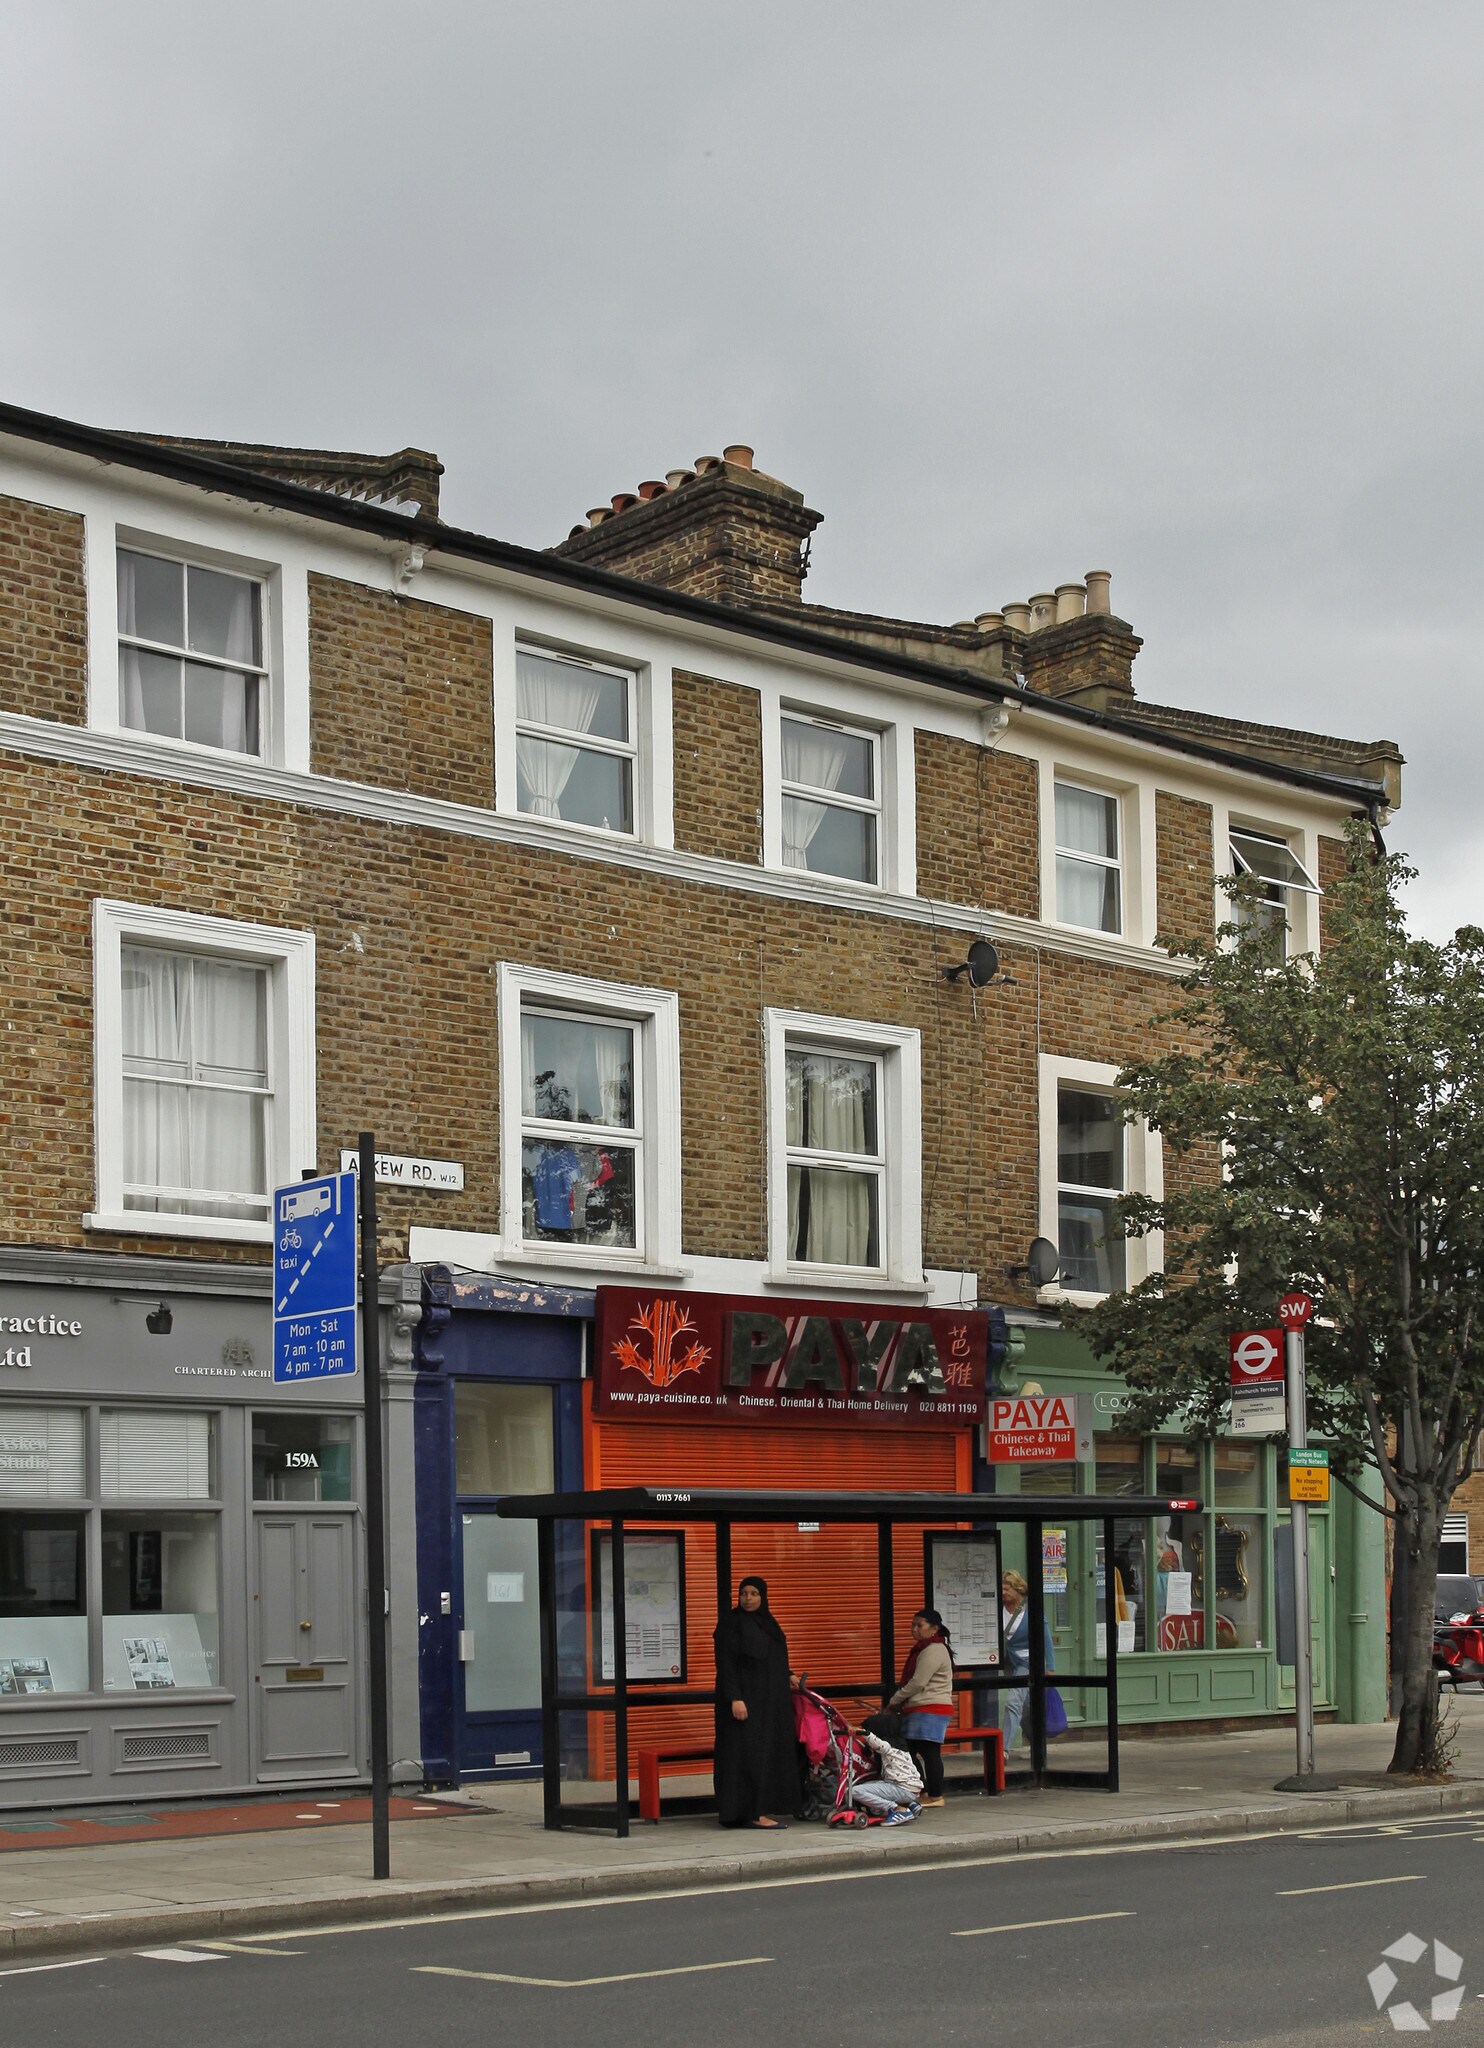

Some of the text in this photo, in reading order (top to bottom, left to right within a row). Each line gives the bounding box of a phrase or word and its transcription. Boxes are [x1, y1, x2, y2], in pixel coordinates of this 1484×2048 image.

[348, 1158, 403, 1177] AKEW
[412, 1165, 436, 1181] RD.
[280, 1255, 298, 1269] taxi
[1280, 1301, 1306, 1318] SW
[290, 1324, 310, 1337] Mon
[320, 1318, 338, 1333] Sat
[283, 1344, 290, 1357] 7
[292, 1346, 306, 1356] am
[316, 1339, 327, 1353] 10
[330, 1339, 345, 1350] am
[729, 1311, 947, 1394] PAYA
[174, 1366, 273, 1378] CHARTERED ARCHI
[285, 1361, 292, 1374] 4
[295, 1362, 310, 1375] pm
[319, 1357, 326, 1370] 7
[328, 1357, 344, 1371] pm
[716, 1395, 727, 1404] uk
[780, 1396, 815, 1408] Oriental
[817, 1398, 824, 1408] &
[827, 1399, 845, 1409] Thai
[848, 1400, 871, 1410] Home
[874, 1401, 908, 1413] Delivery
[919, 1402, 934, 1412] 020
[937, 1403, 955, 1413] 8811
[958, 1404, 977, 1413] 1199
[993, 1398, 1070, 1429] PAYA
[994, 1430, 1070, 1445] Chinese & Thai
[1008, 1446, 1057, 1457] Takeaway
[285, 1452, 319, 1468] 159A
[1291, 1457, 1308, 1465] Priority
[656, 1493, 691, 1502] 0113 7661
[1042, 1545, 1062, 1558] AIR
